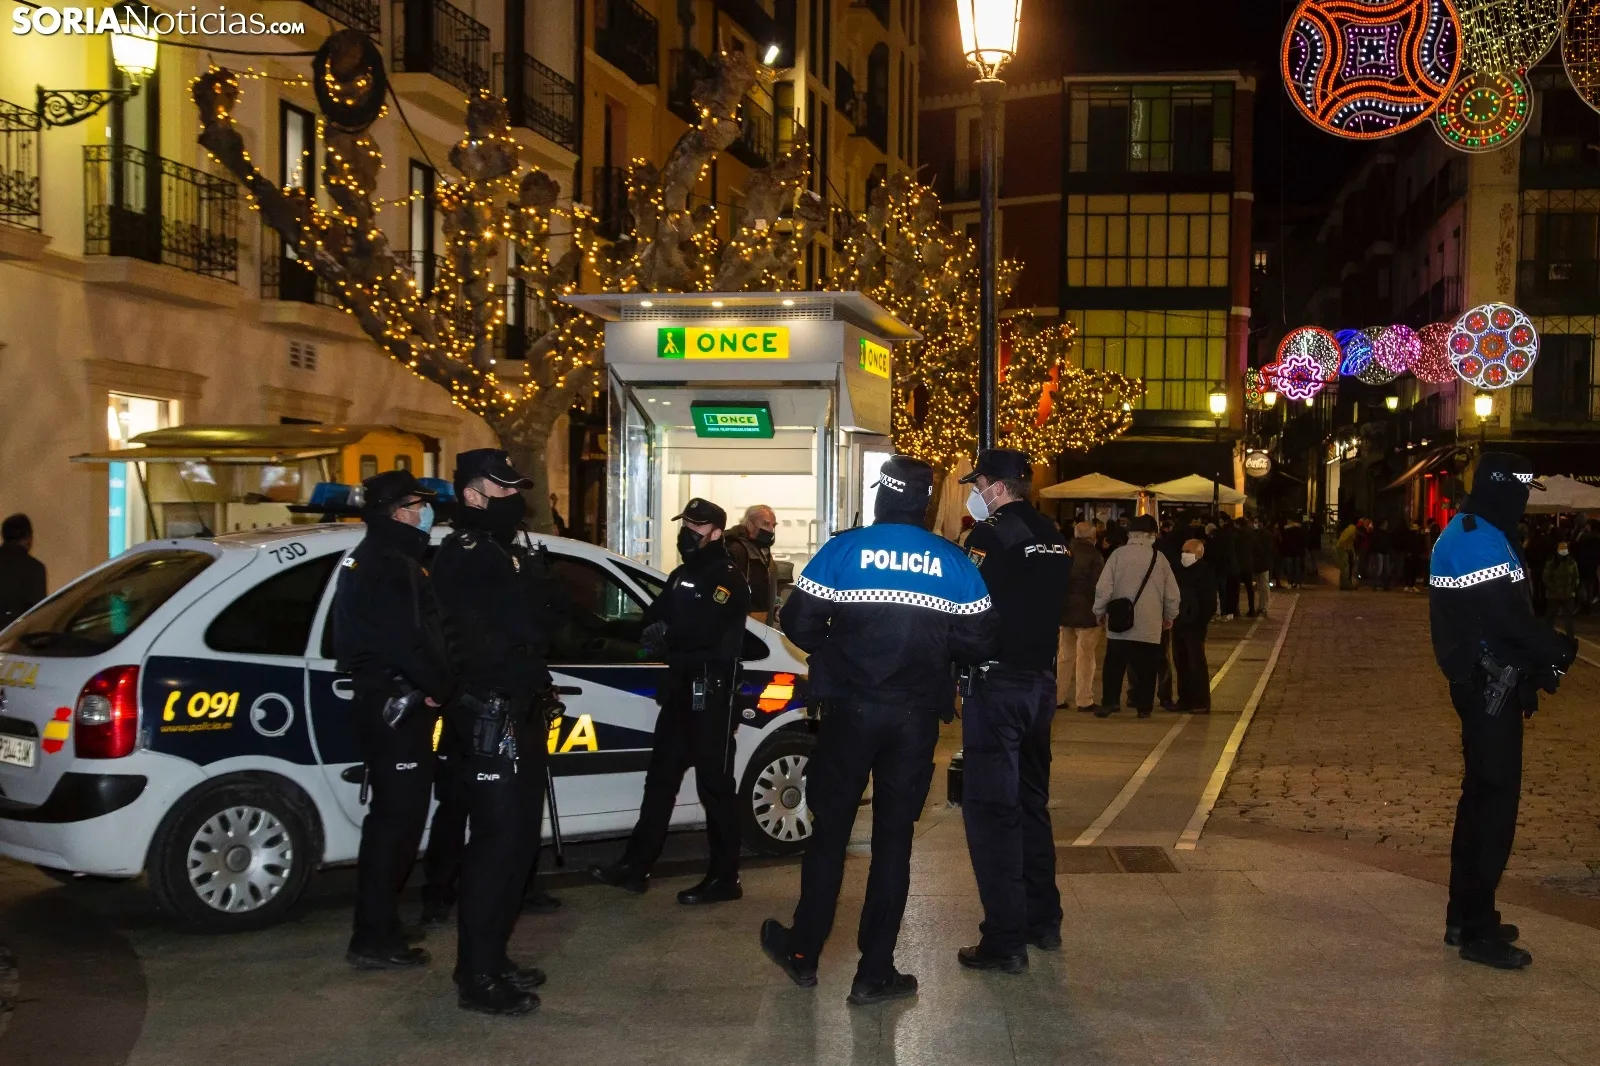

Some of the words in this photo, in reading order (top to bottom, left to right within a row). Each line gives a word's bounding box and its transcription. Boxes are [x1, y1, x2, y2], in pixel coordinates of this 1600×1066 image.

[697, 333, 777, 352] ONCE
[868, 348, 887, 372] ONCE
[720, 416, 754, 424] ONCE
[268, 542, 307, 564] 73D
[860, 549, 943, 578] POLICÍA
[187, 691, 240, 719] 091
[395, 762, 418, 770] CNP
[477, 773, 500, 781] CNP
